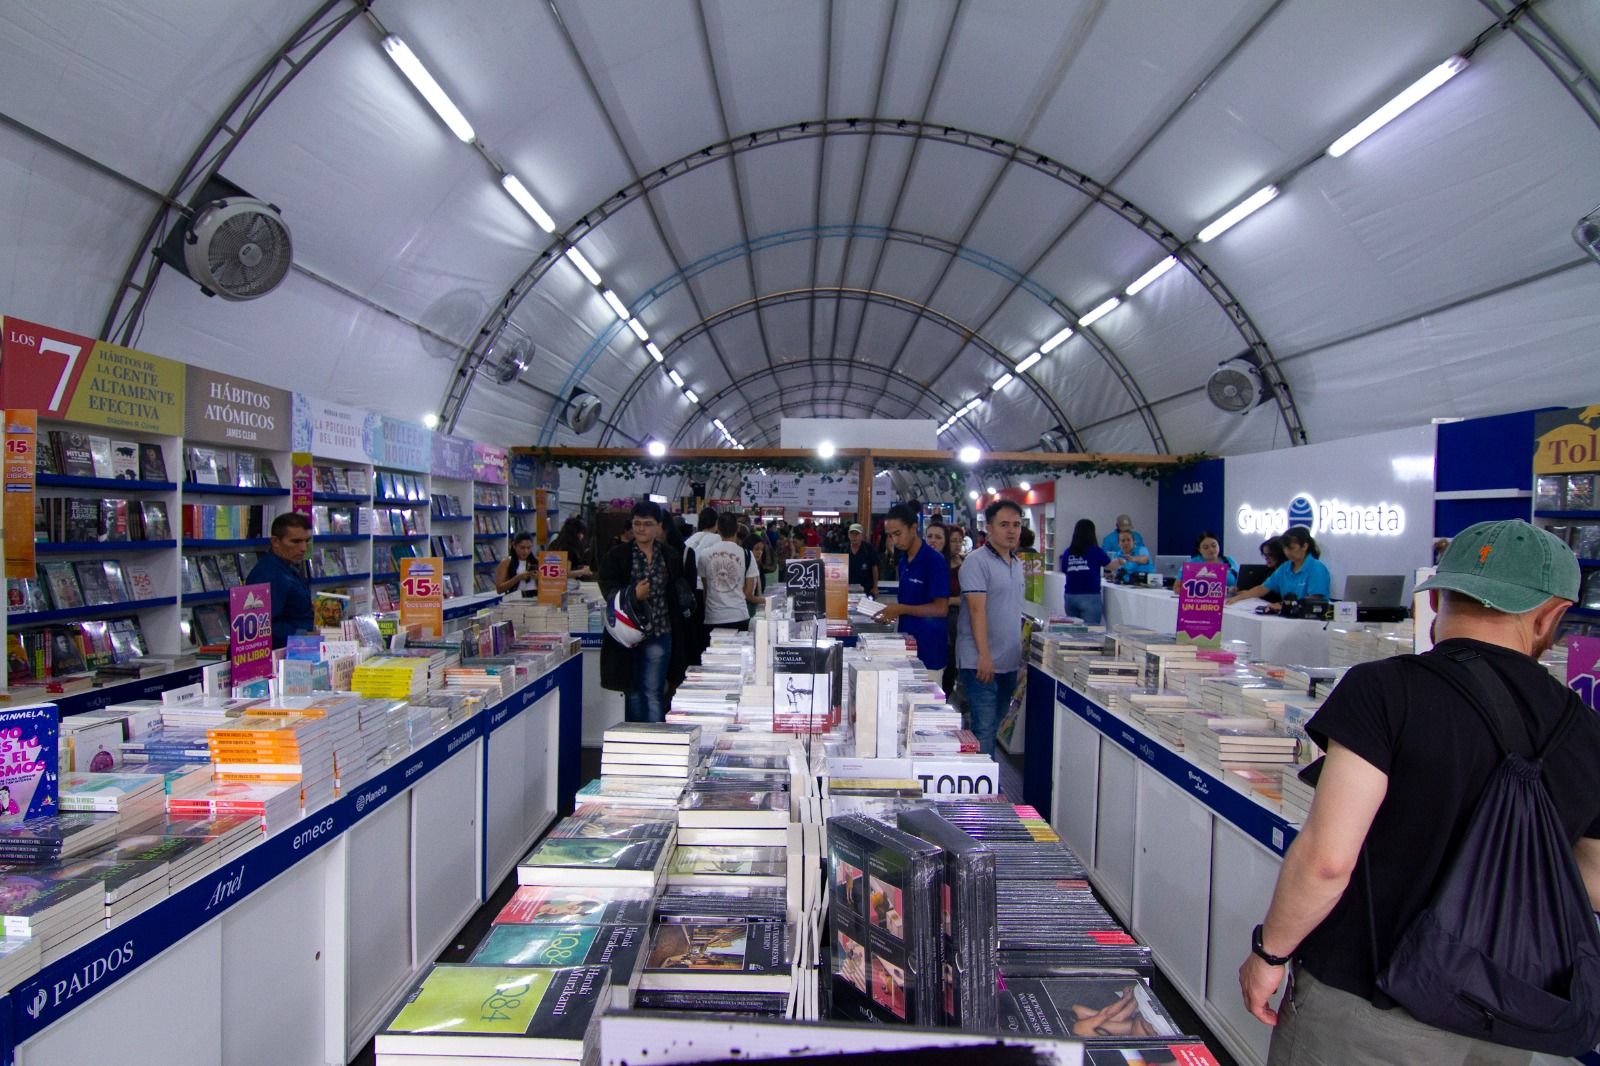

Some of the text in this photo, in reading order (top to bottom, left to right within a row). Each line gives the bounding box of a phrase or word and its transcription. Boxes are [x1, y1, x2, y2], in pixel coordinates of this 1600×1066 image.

[11, 331, 35, 347] LOS
[100, 350, 156, 372] HÁBITOS DE
[38, 337, 82, 411] 7
[97, 363, 158, 387] LA GENTE
[90, 377, 175, 406] ALTAMENTE
[210, 382, 271, 409] HÁBITOS
[88, 395, 160, 421] EFECTIVA
[204, 403, 275, 430] ATÓMICOS
[1183, 481, 1203, 495] CAJAS
[1319, 501, 1402, 533] Planeta
[402, 577, 440, 597] 15%
[787, 562, 820, 589] 2x1
[1183, 579, 1222, 598] 10%
[1182, 603, 1194, 611] UN
[232, 613, 270, 643] 10%
[258, 627, 271, 637] DTO
[233, 648, 271, 665] UN LIBRO
[235, 639, 269, 653] POR COMPRA DE
[19, 734, 39, 750] TÚ
[447, 727, 476, 753] minotauro
[12, 750, 30, 764] EL
[405, 760, 424, 778] DESTINO
[364, 784, 388, 805] Planeta
[917, 775, 993, 795] TODO
[292, 817, 334, 850] emece
[205, 865, 245, 911] Ariel
[600, 926, 627, 964] Murakami
[621, 926, 639, 948] Haruki
[771, 930, 780, 968] TRANSPARENCIA
[52, 940, 134, 1008] PAIDOS
[578, 968, 600, 996] Haruki
[552, 967, 586, 1016] Murakami
